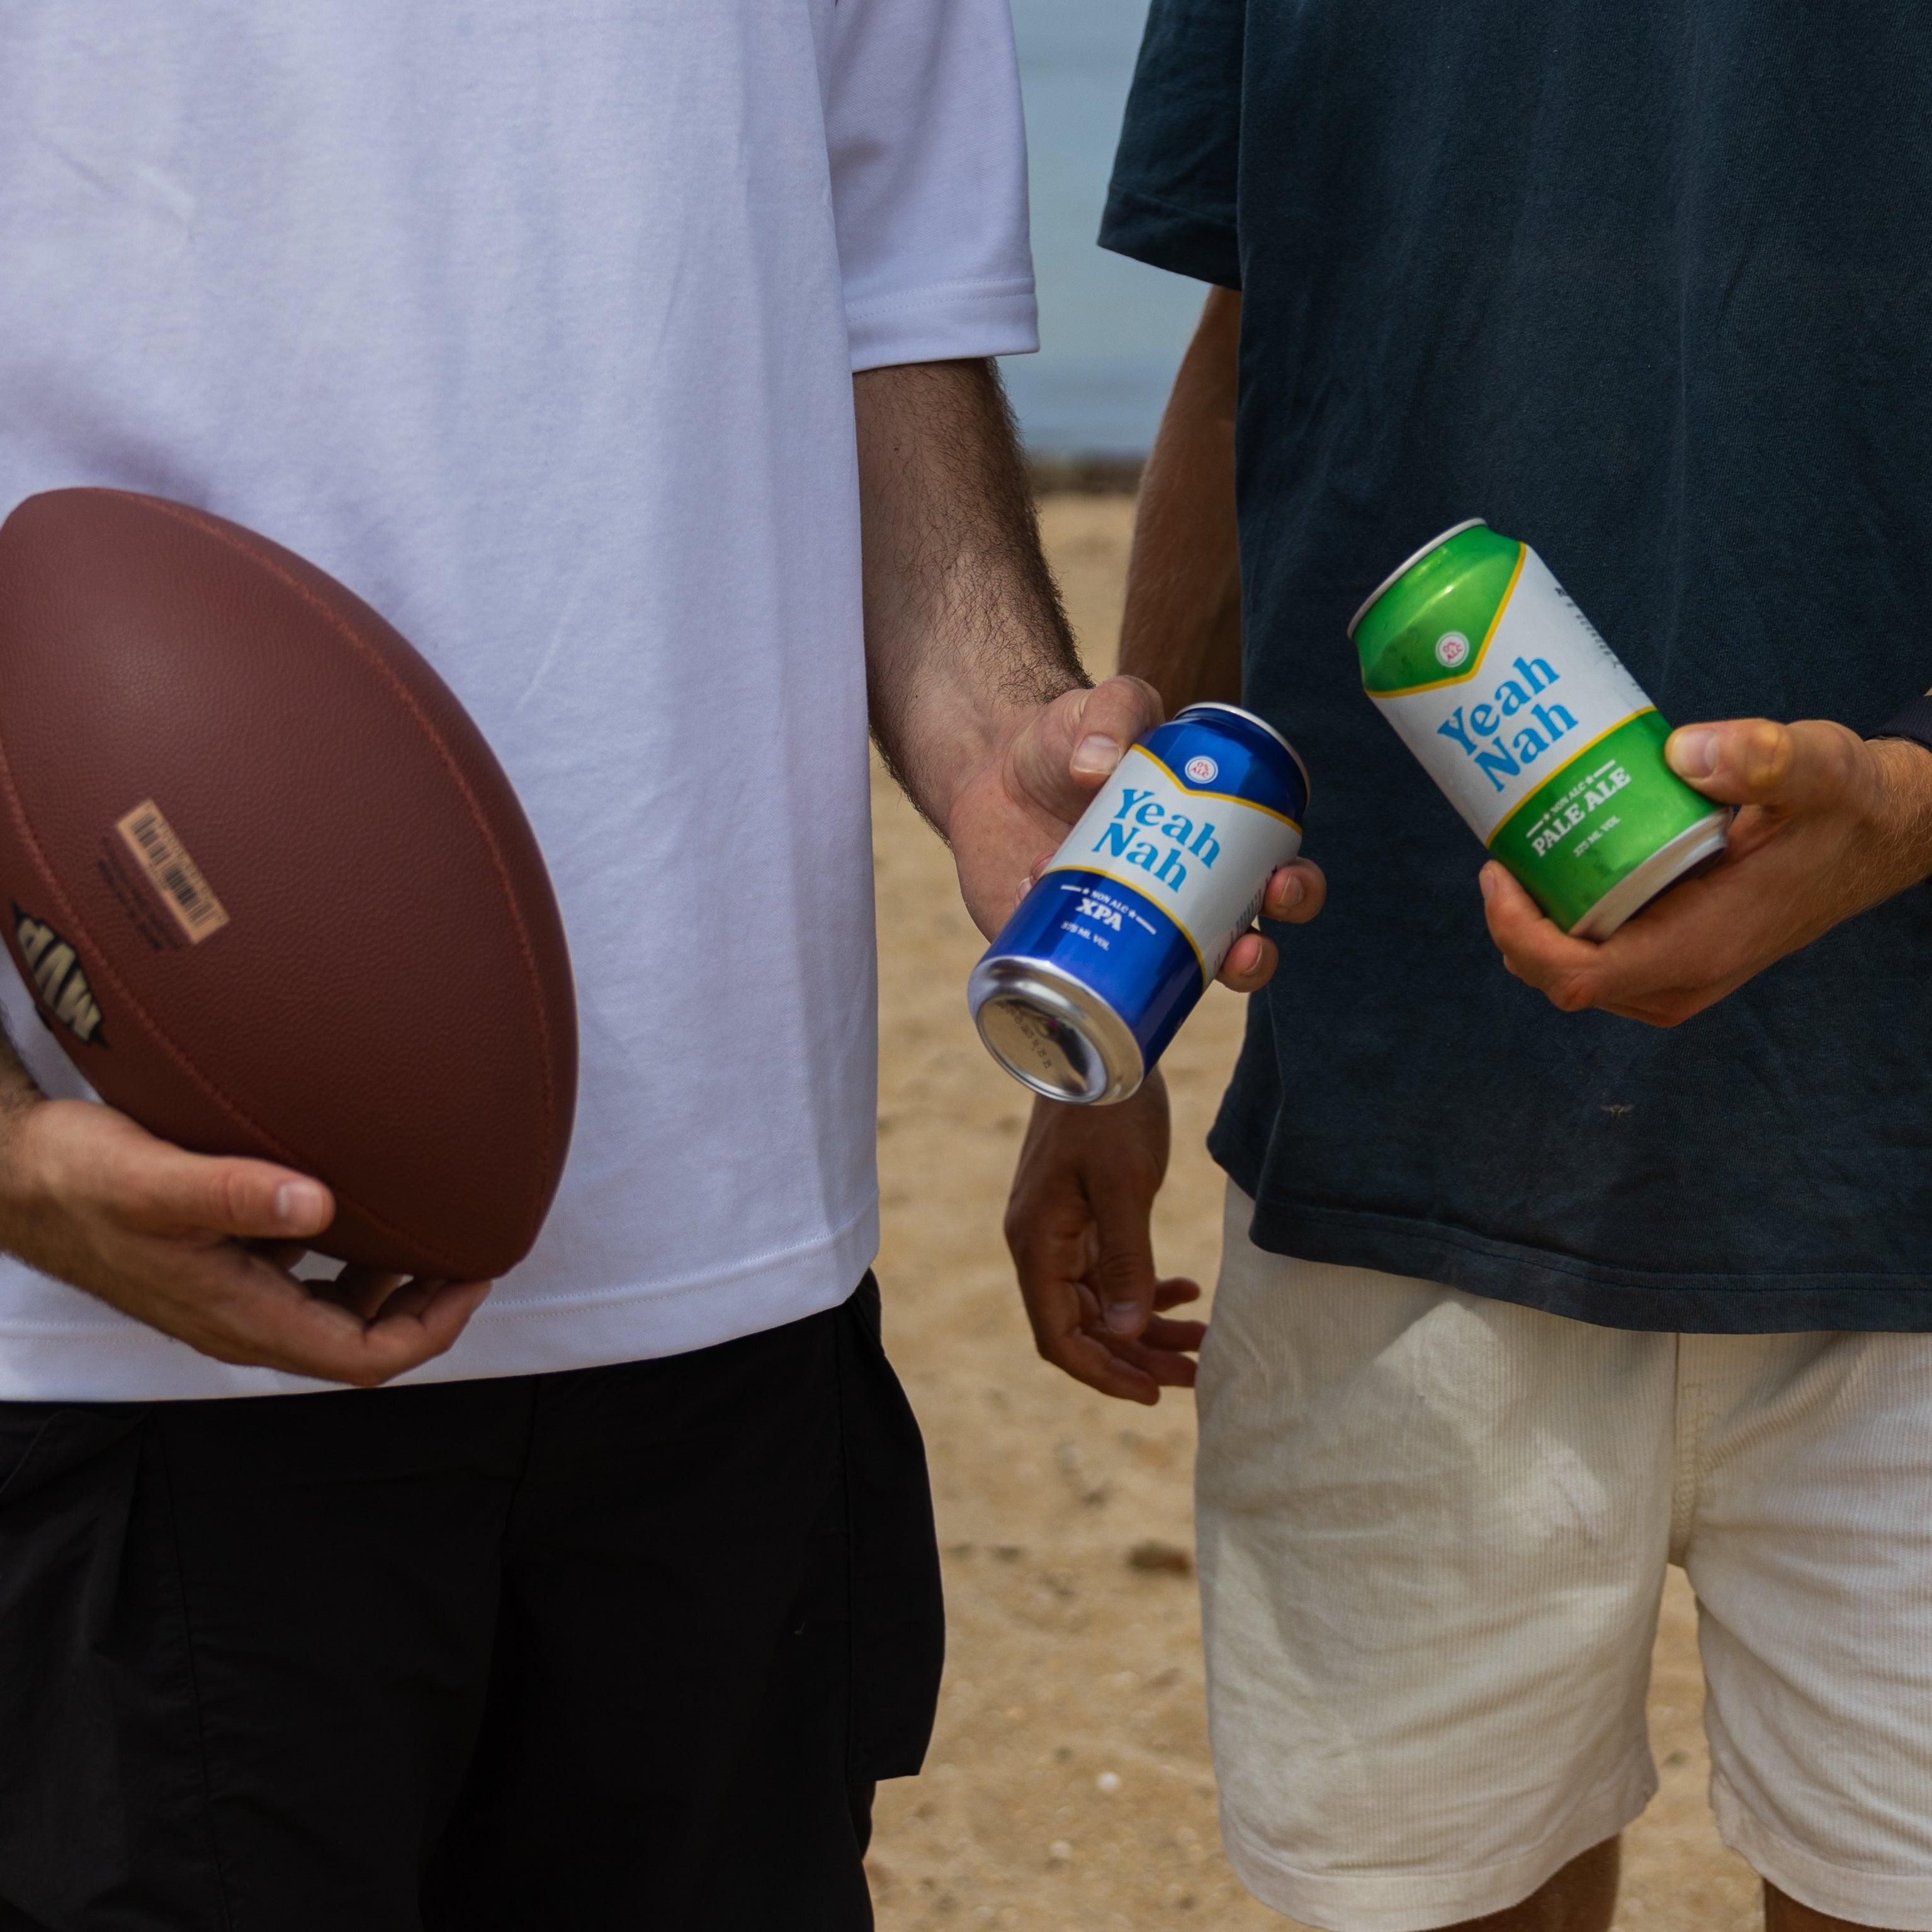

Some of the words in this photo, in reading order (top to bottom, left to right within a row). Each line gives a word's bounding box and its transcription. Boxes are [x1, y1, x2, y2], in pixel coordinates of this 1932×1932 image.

[1437, 656, 1560, 755] Yeah
[1474, 703, 1579, 792] Nah
[1531, 803, 1586, 857] PALE
[1584, 766, 1632, 812] ALE
[1569, 782, 1586, 801] ALC
[1600, 815, 1621, 832] VOL
[1092, 822, 1187, 893] Nah
[1113, 788, 1220, 869] Yeah
[1075, 897, 1122, 932] XPA
[1090, 890, 1112, 904] NON
[1109, 899, 1129, 913] ALC
[1092, 933, 1110, 951] VOL
[18, 917, 102, 1041] MVP
